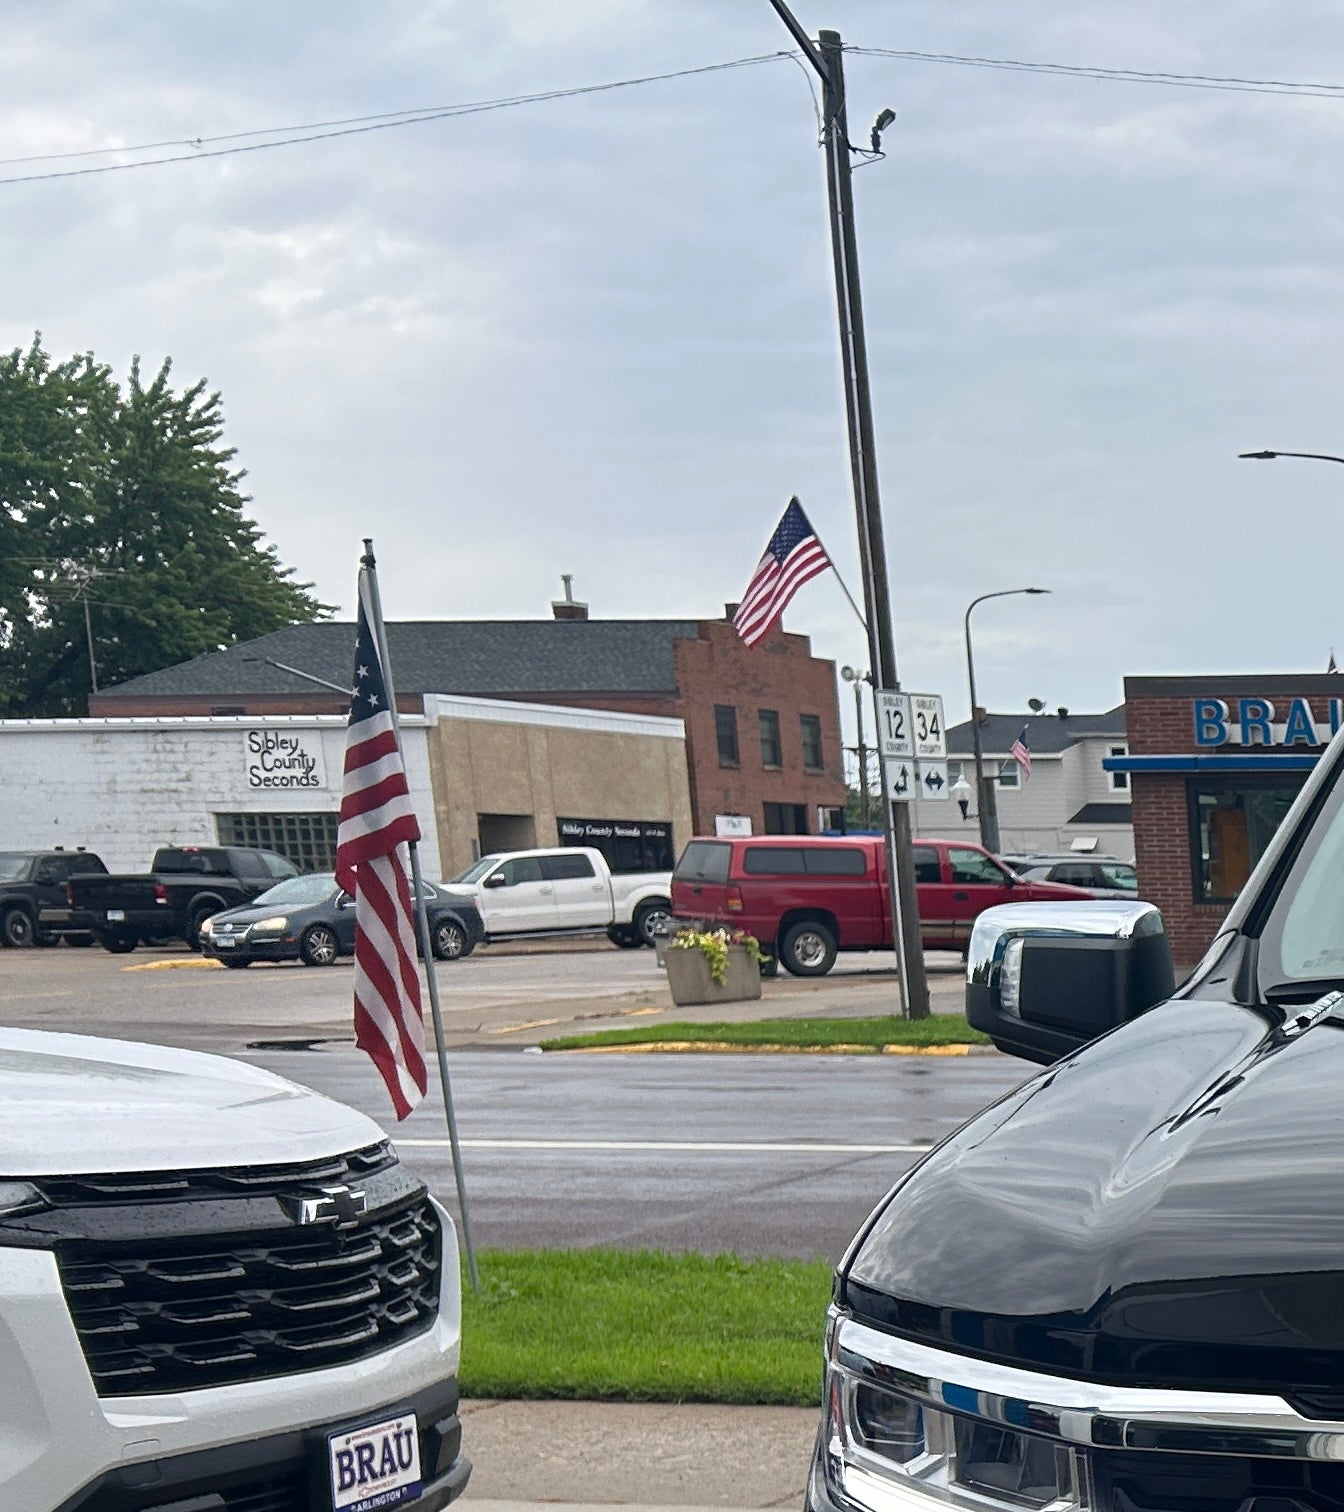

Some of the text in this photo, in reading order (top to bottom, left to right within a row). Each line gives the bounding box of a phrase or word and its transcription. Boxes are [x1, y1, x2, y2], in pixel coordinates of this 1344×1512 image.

[885, 709, 905, 739] 12
[917, 711, 941, 742] 34
[248, 731, 299, 757] Sibley
[260, 749, 316, 774] County
[249, 765, 320, 787] Seconds
[585, 825, 613, 838] County
[336, 1428, 414, 1492] BRAU
[356, 1489, 401, 1512] ARLINGTON
